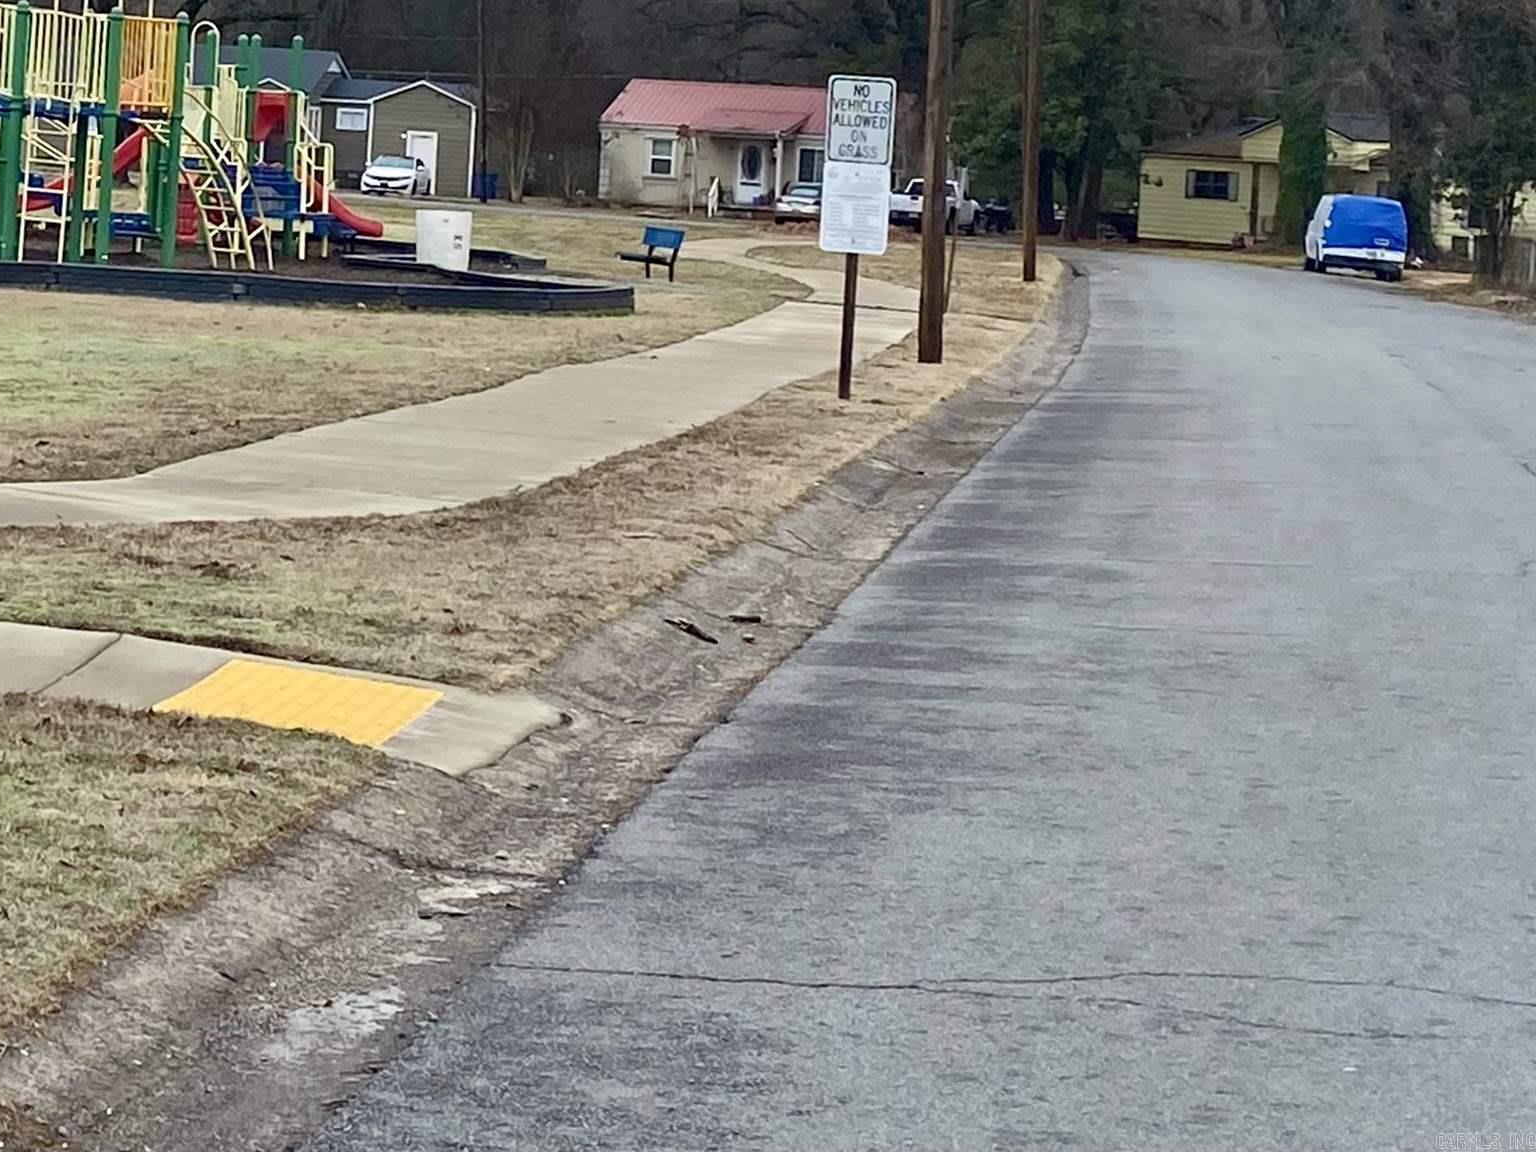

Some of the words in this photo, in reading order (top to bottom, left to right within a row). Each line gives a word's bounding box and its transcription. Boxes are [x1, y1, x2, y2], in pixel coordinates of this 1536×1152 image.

[853, 84, 871, 98] NO
[832, 97, 890, 114] VEHICLES
[833, 113, 888, 129] ALLOWED
[850, 129, 868, 143] ON
[838, 143, 878, 159] GRASS
